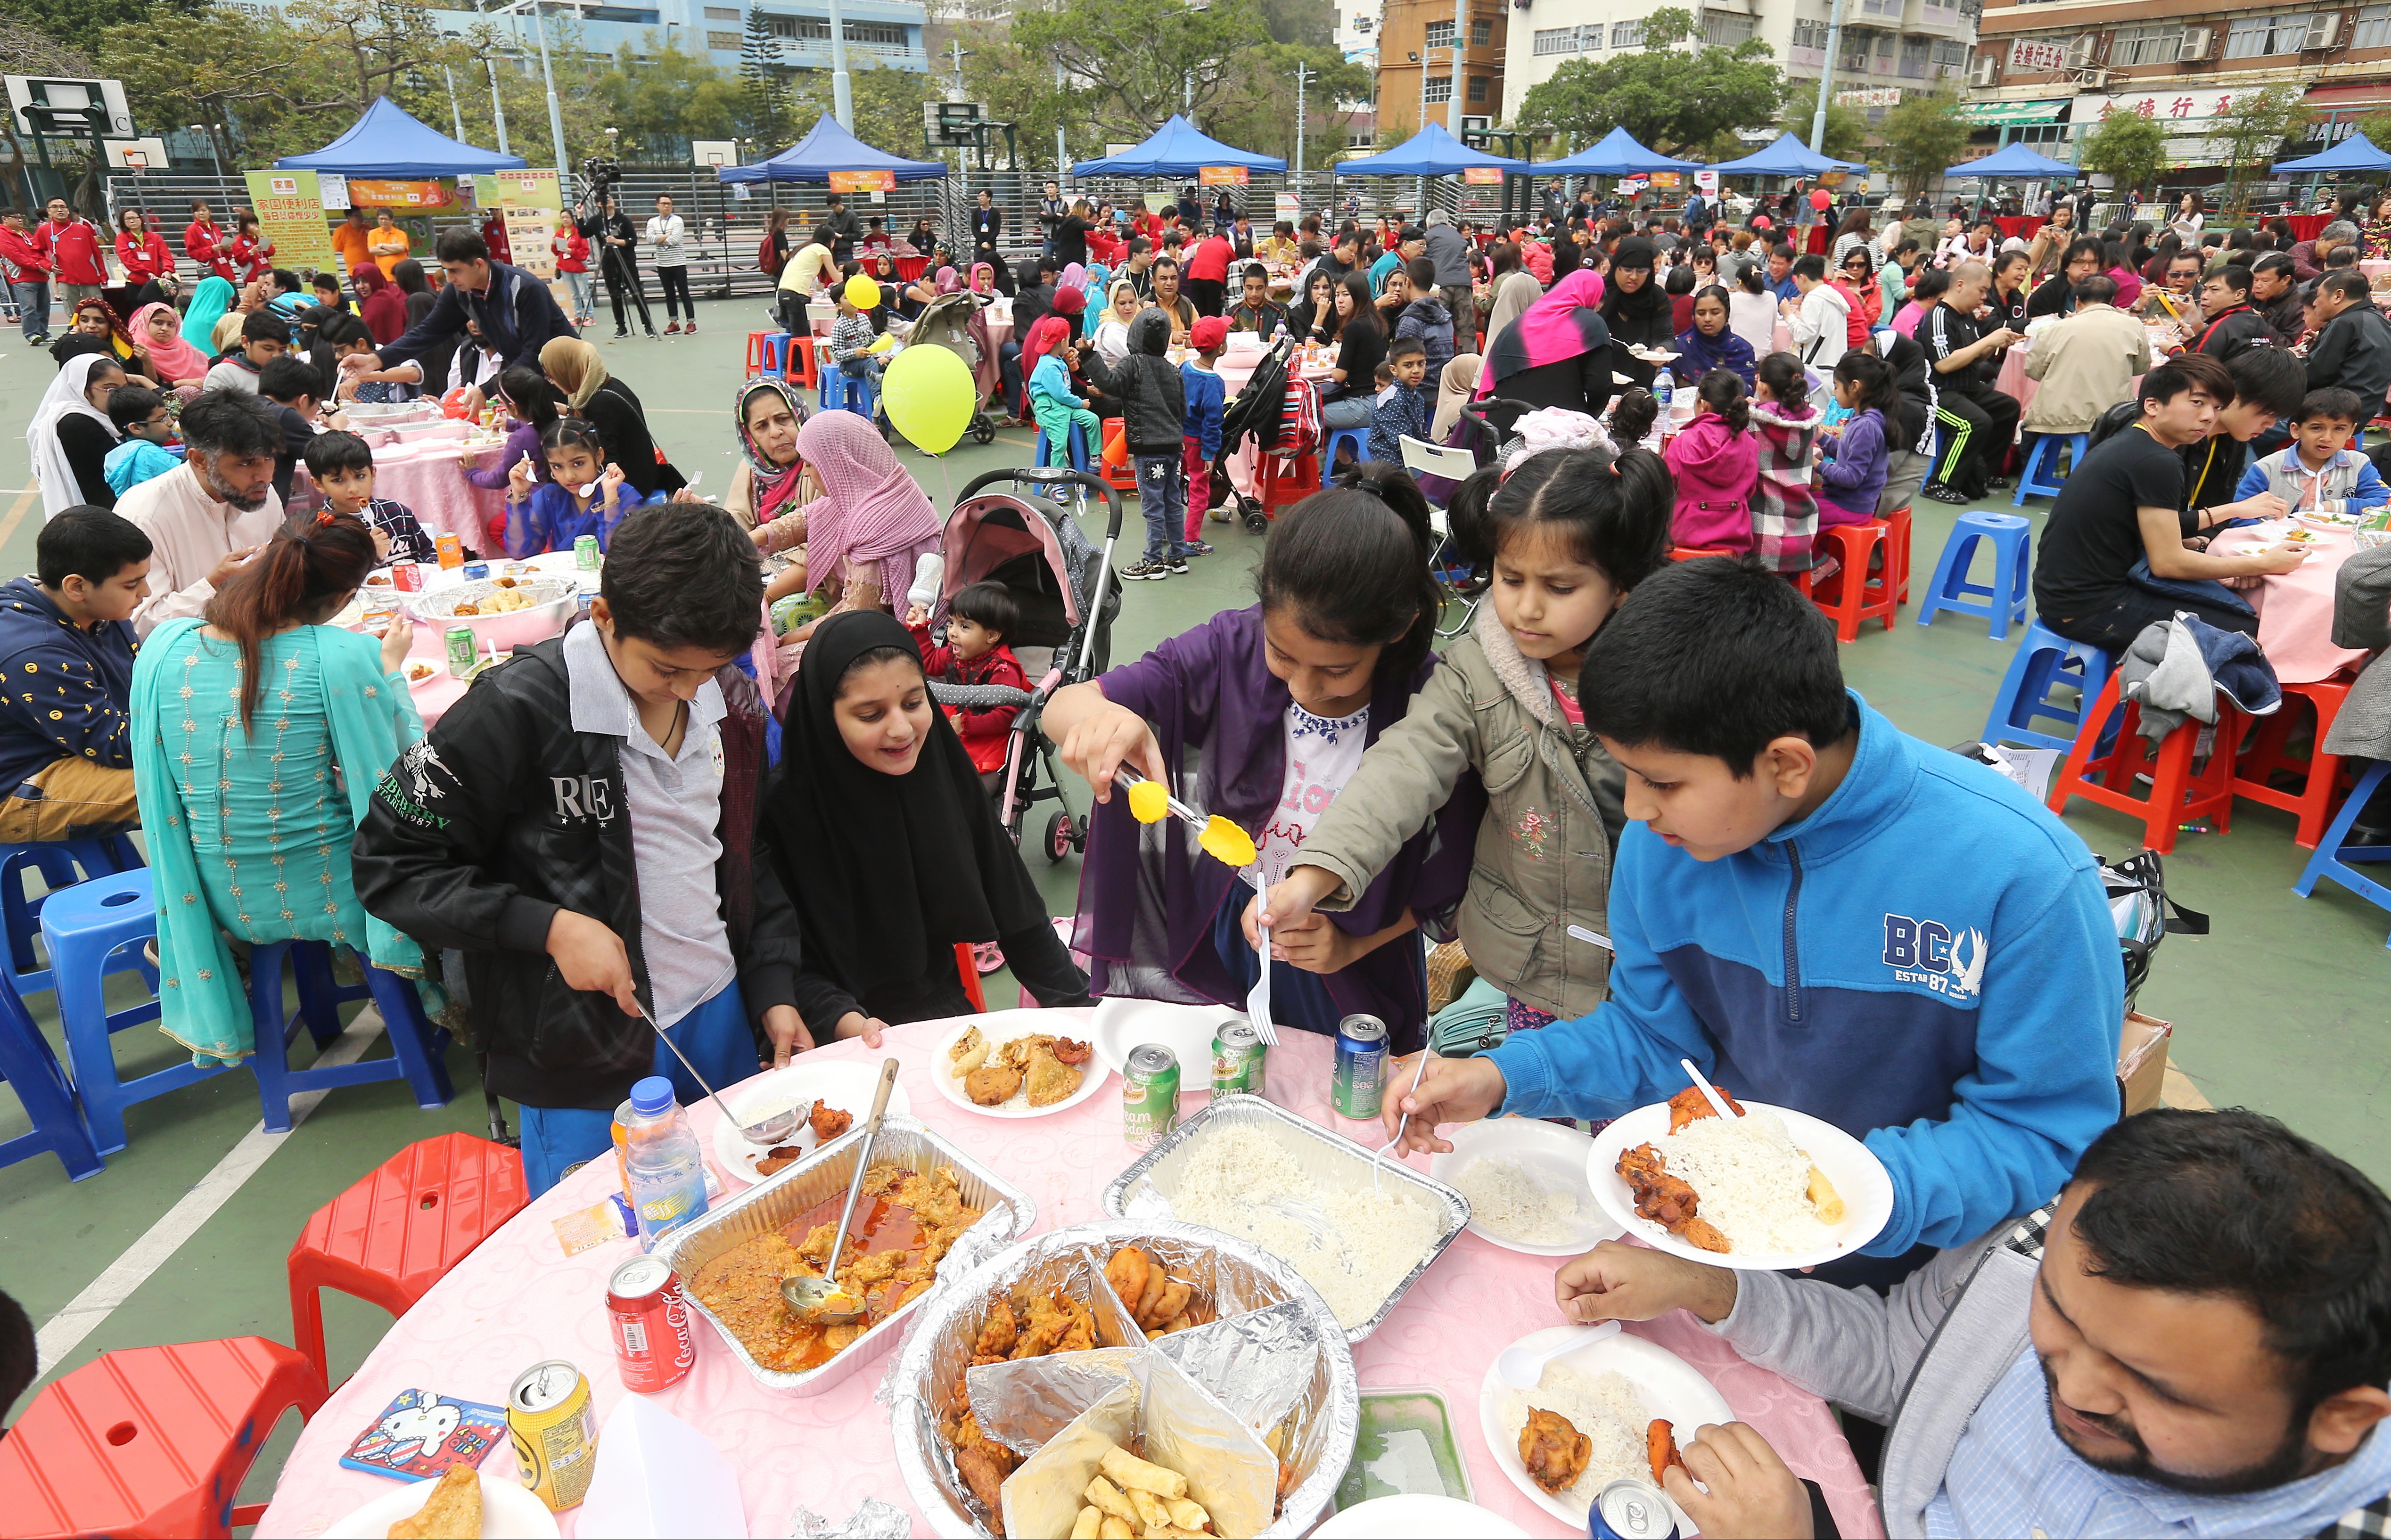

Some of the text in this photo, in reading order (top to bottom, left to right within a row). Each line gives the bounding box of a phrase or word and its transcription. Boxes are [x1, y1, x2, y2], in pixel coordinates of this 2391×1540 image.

[2014, 41, 2063, 68] 全德行五金
[2095, 94, 2270, 122] 全德行五
[115, 117, 130, 132] C
[256, 198, 320, 210] 家園便利店
[550, 774, 615, 820] RUE
[404, 814, 432, 827] 1987
[1883, 913, 1951, 975] BC
[1929, 974, 1949, 993] 87
[1212, 1086, 1243, 1098] ream
[1124, 1111, 1152, 1125] eam
[1124, 1125, 1145, 1136] oda
